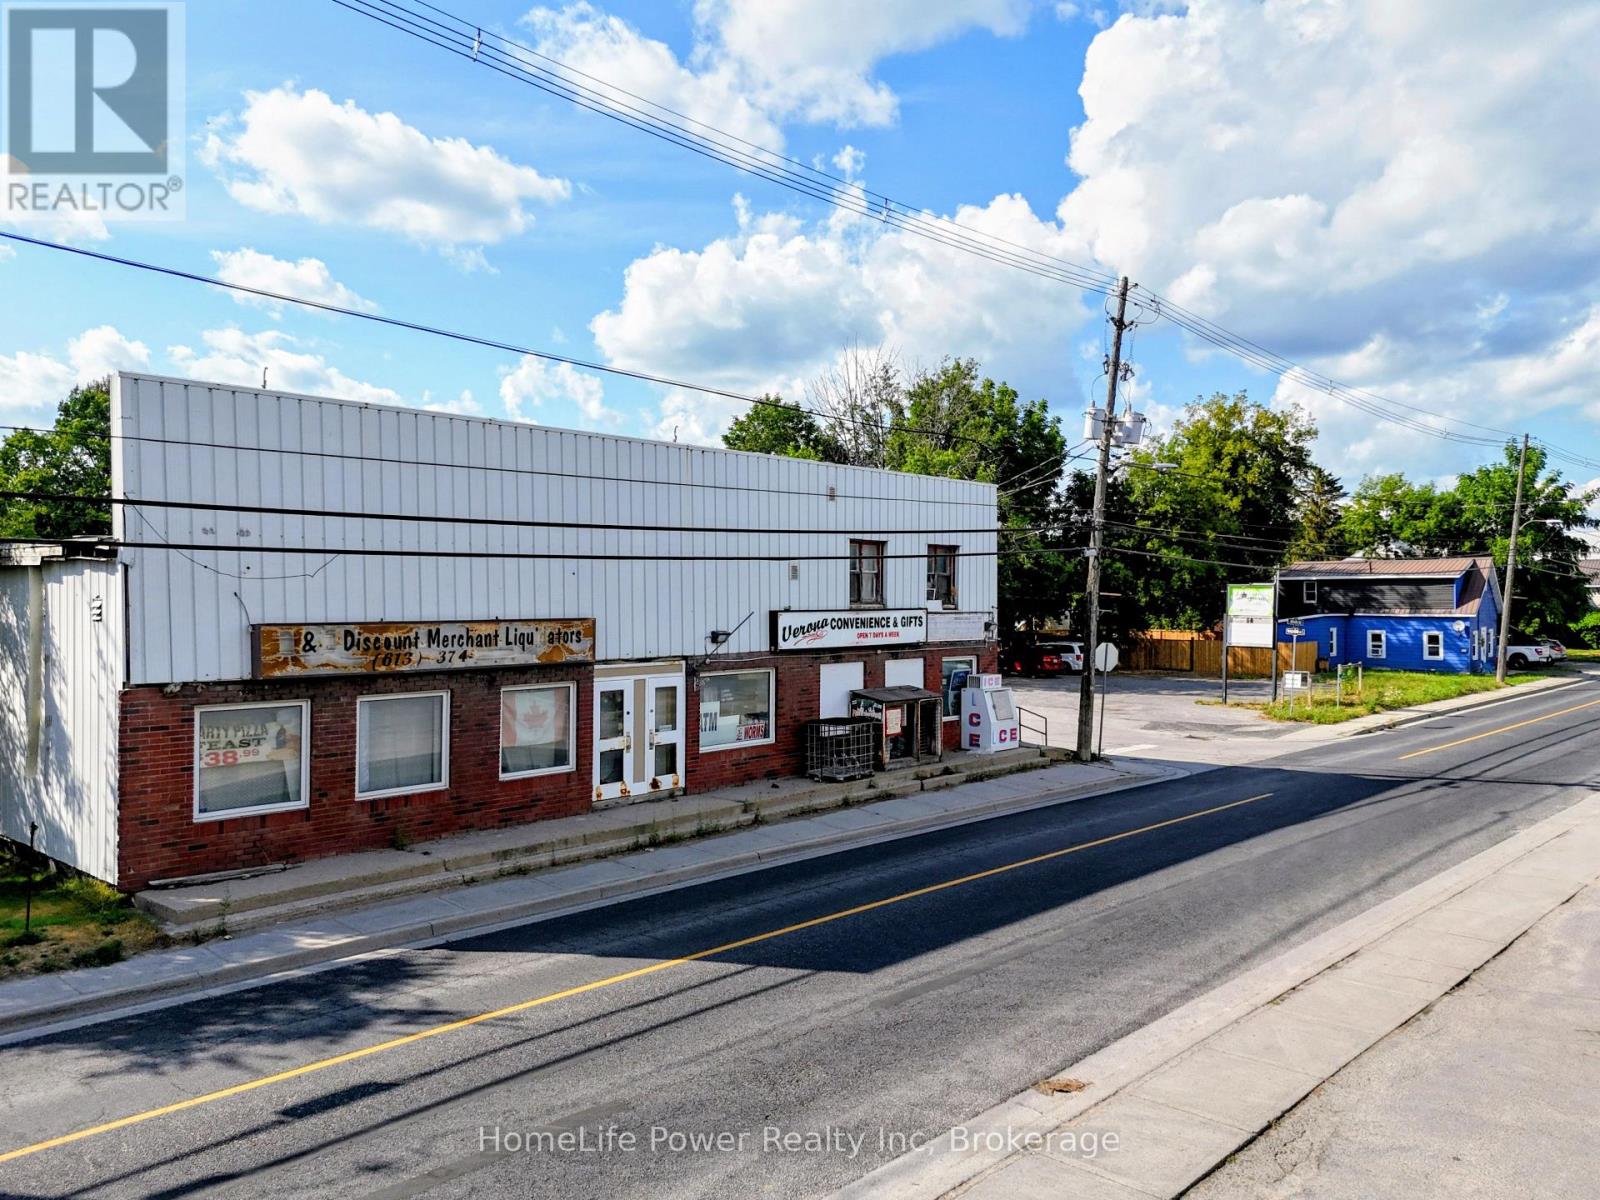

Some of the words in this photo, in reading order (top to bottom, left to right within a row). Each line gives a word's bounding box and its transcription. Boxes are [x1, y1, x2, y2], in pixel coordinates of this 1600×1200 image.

[302, 631, 316, 653] &
[344, 630, 420, 652] Discount
[427, 627, 499, 648] Merchant
[782, 618, 829, 642] Verona
[830, 617, 891, 630] CONVENIENCE
[893, 617, 898, 627] &
[901, 616, 923, 628] GIFTS
[984, 677, 1000, 686] ICE
